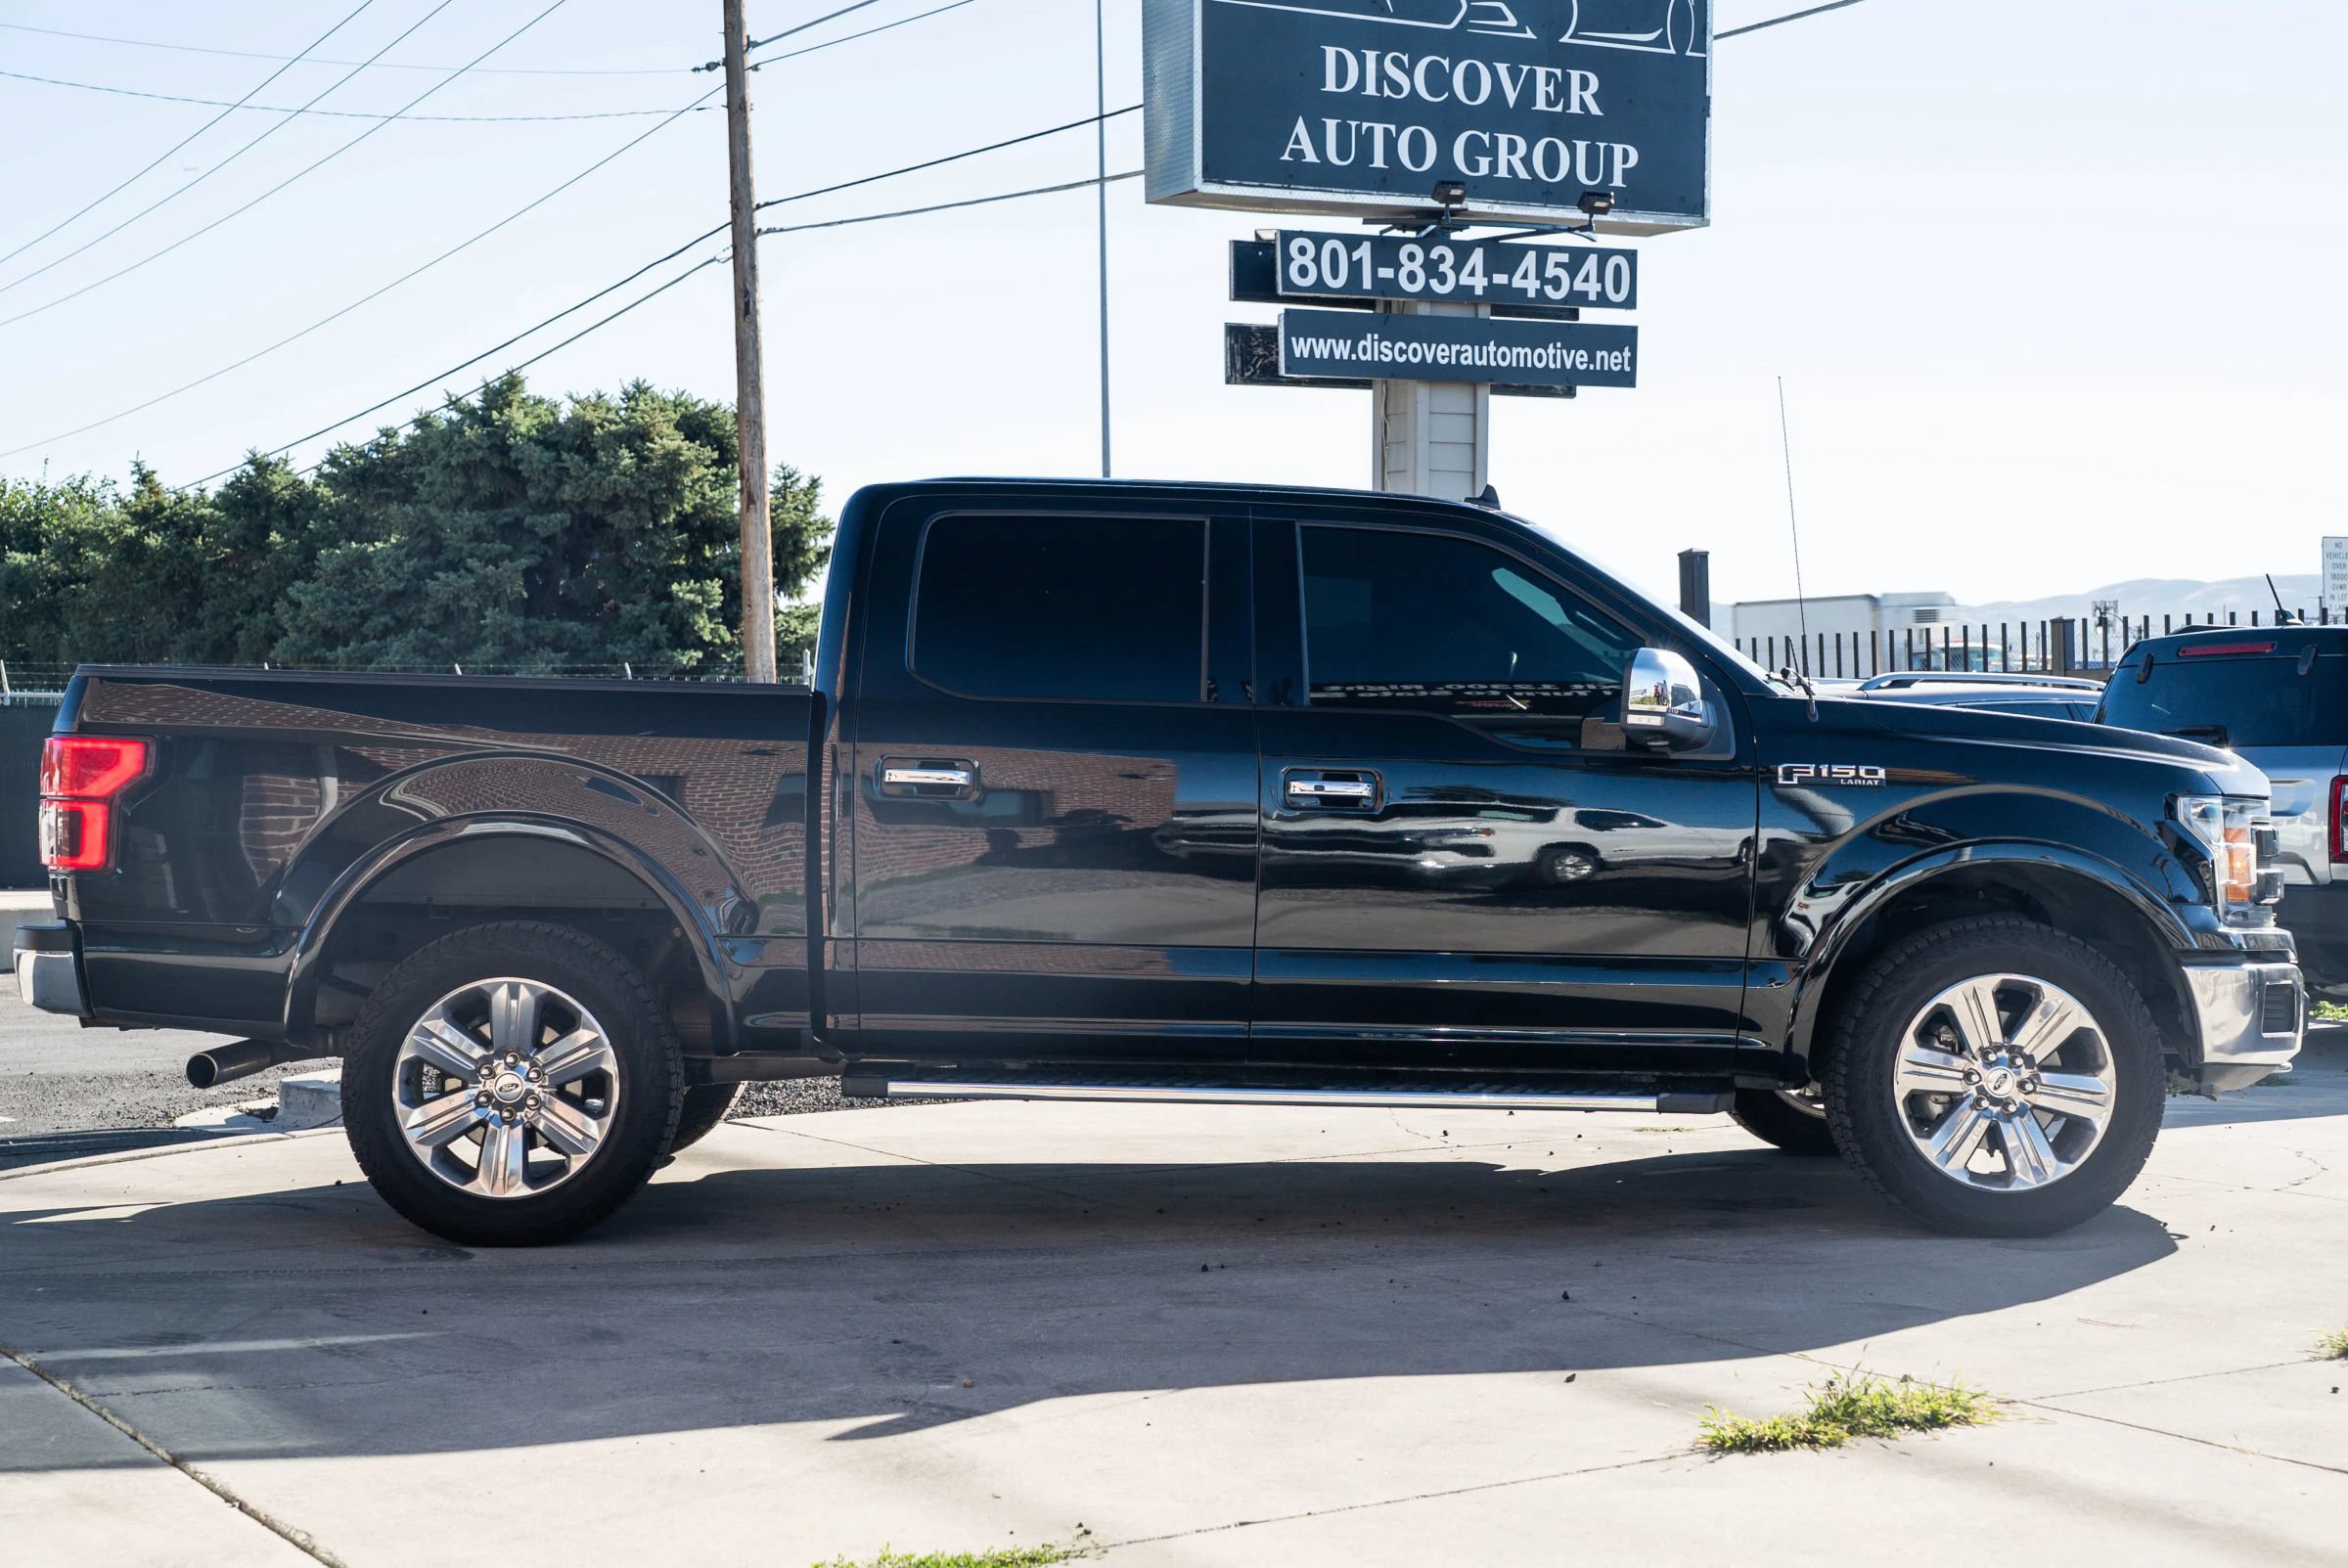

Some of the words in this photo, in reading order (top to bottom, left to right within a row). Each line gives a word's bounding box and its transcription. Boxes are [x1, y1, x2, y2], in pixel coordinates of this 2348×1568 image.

[1321, 45, 1603, 116] DISCOVER
[1281, 116, 1436, 172] AUTO
[1454, 130, 1639, 188] GROUP
[1288, 238, 1631, 302] 801-834-4540
[1291, 333, 1631, 372] www.discoverautomotive.net
